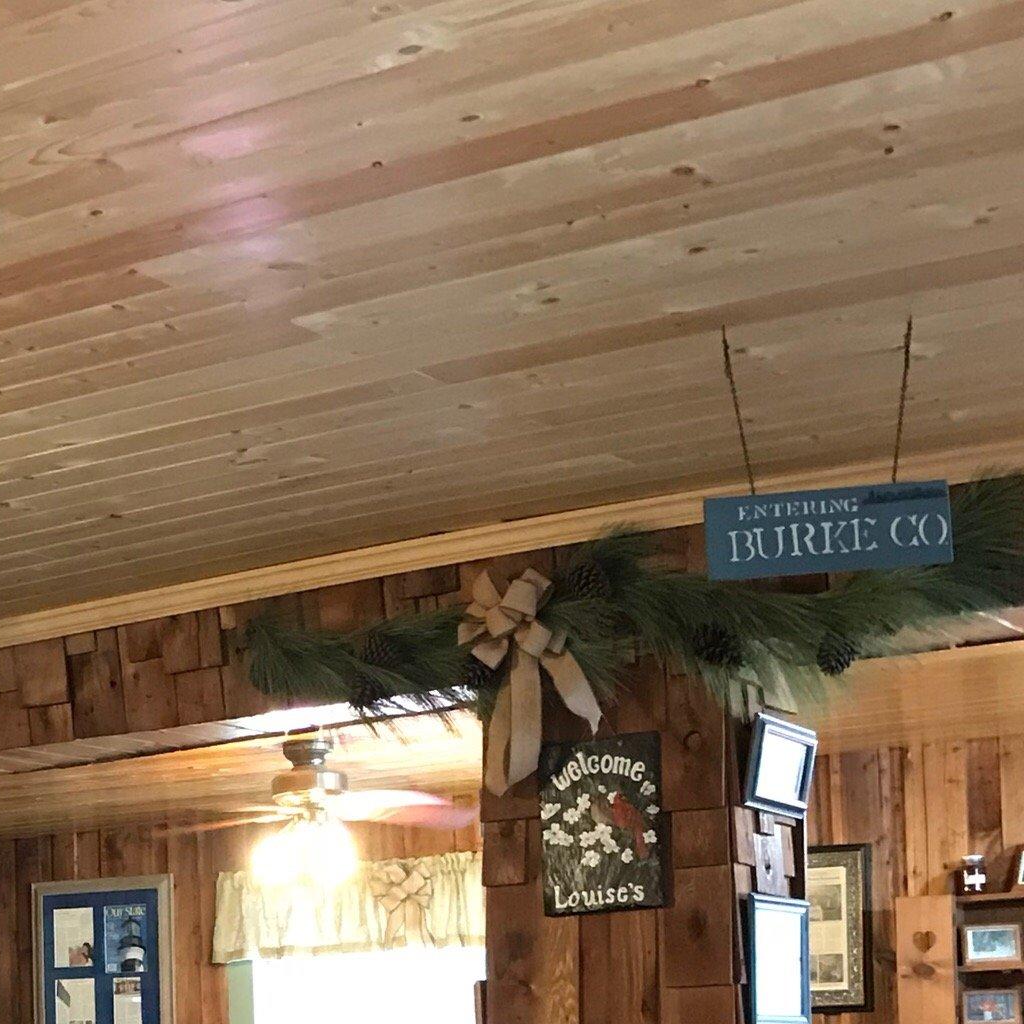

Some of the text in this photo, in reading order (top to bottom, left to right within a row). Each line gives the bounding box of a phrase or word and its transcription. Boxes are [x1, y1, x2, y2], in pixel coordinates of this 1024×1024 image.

[738, 497, 859, 521] ENTERING
[727, 517, 878, 562] BURKE
[551, 751, 646, 791] welcome
[554, 882, 645, 909] Louise's
